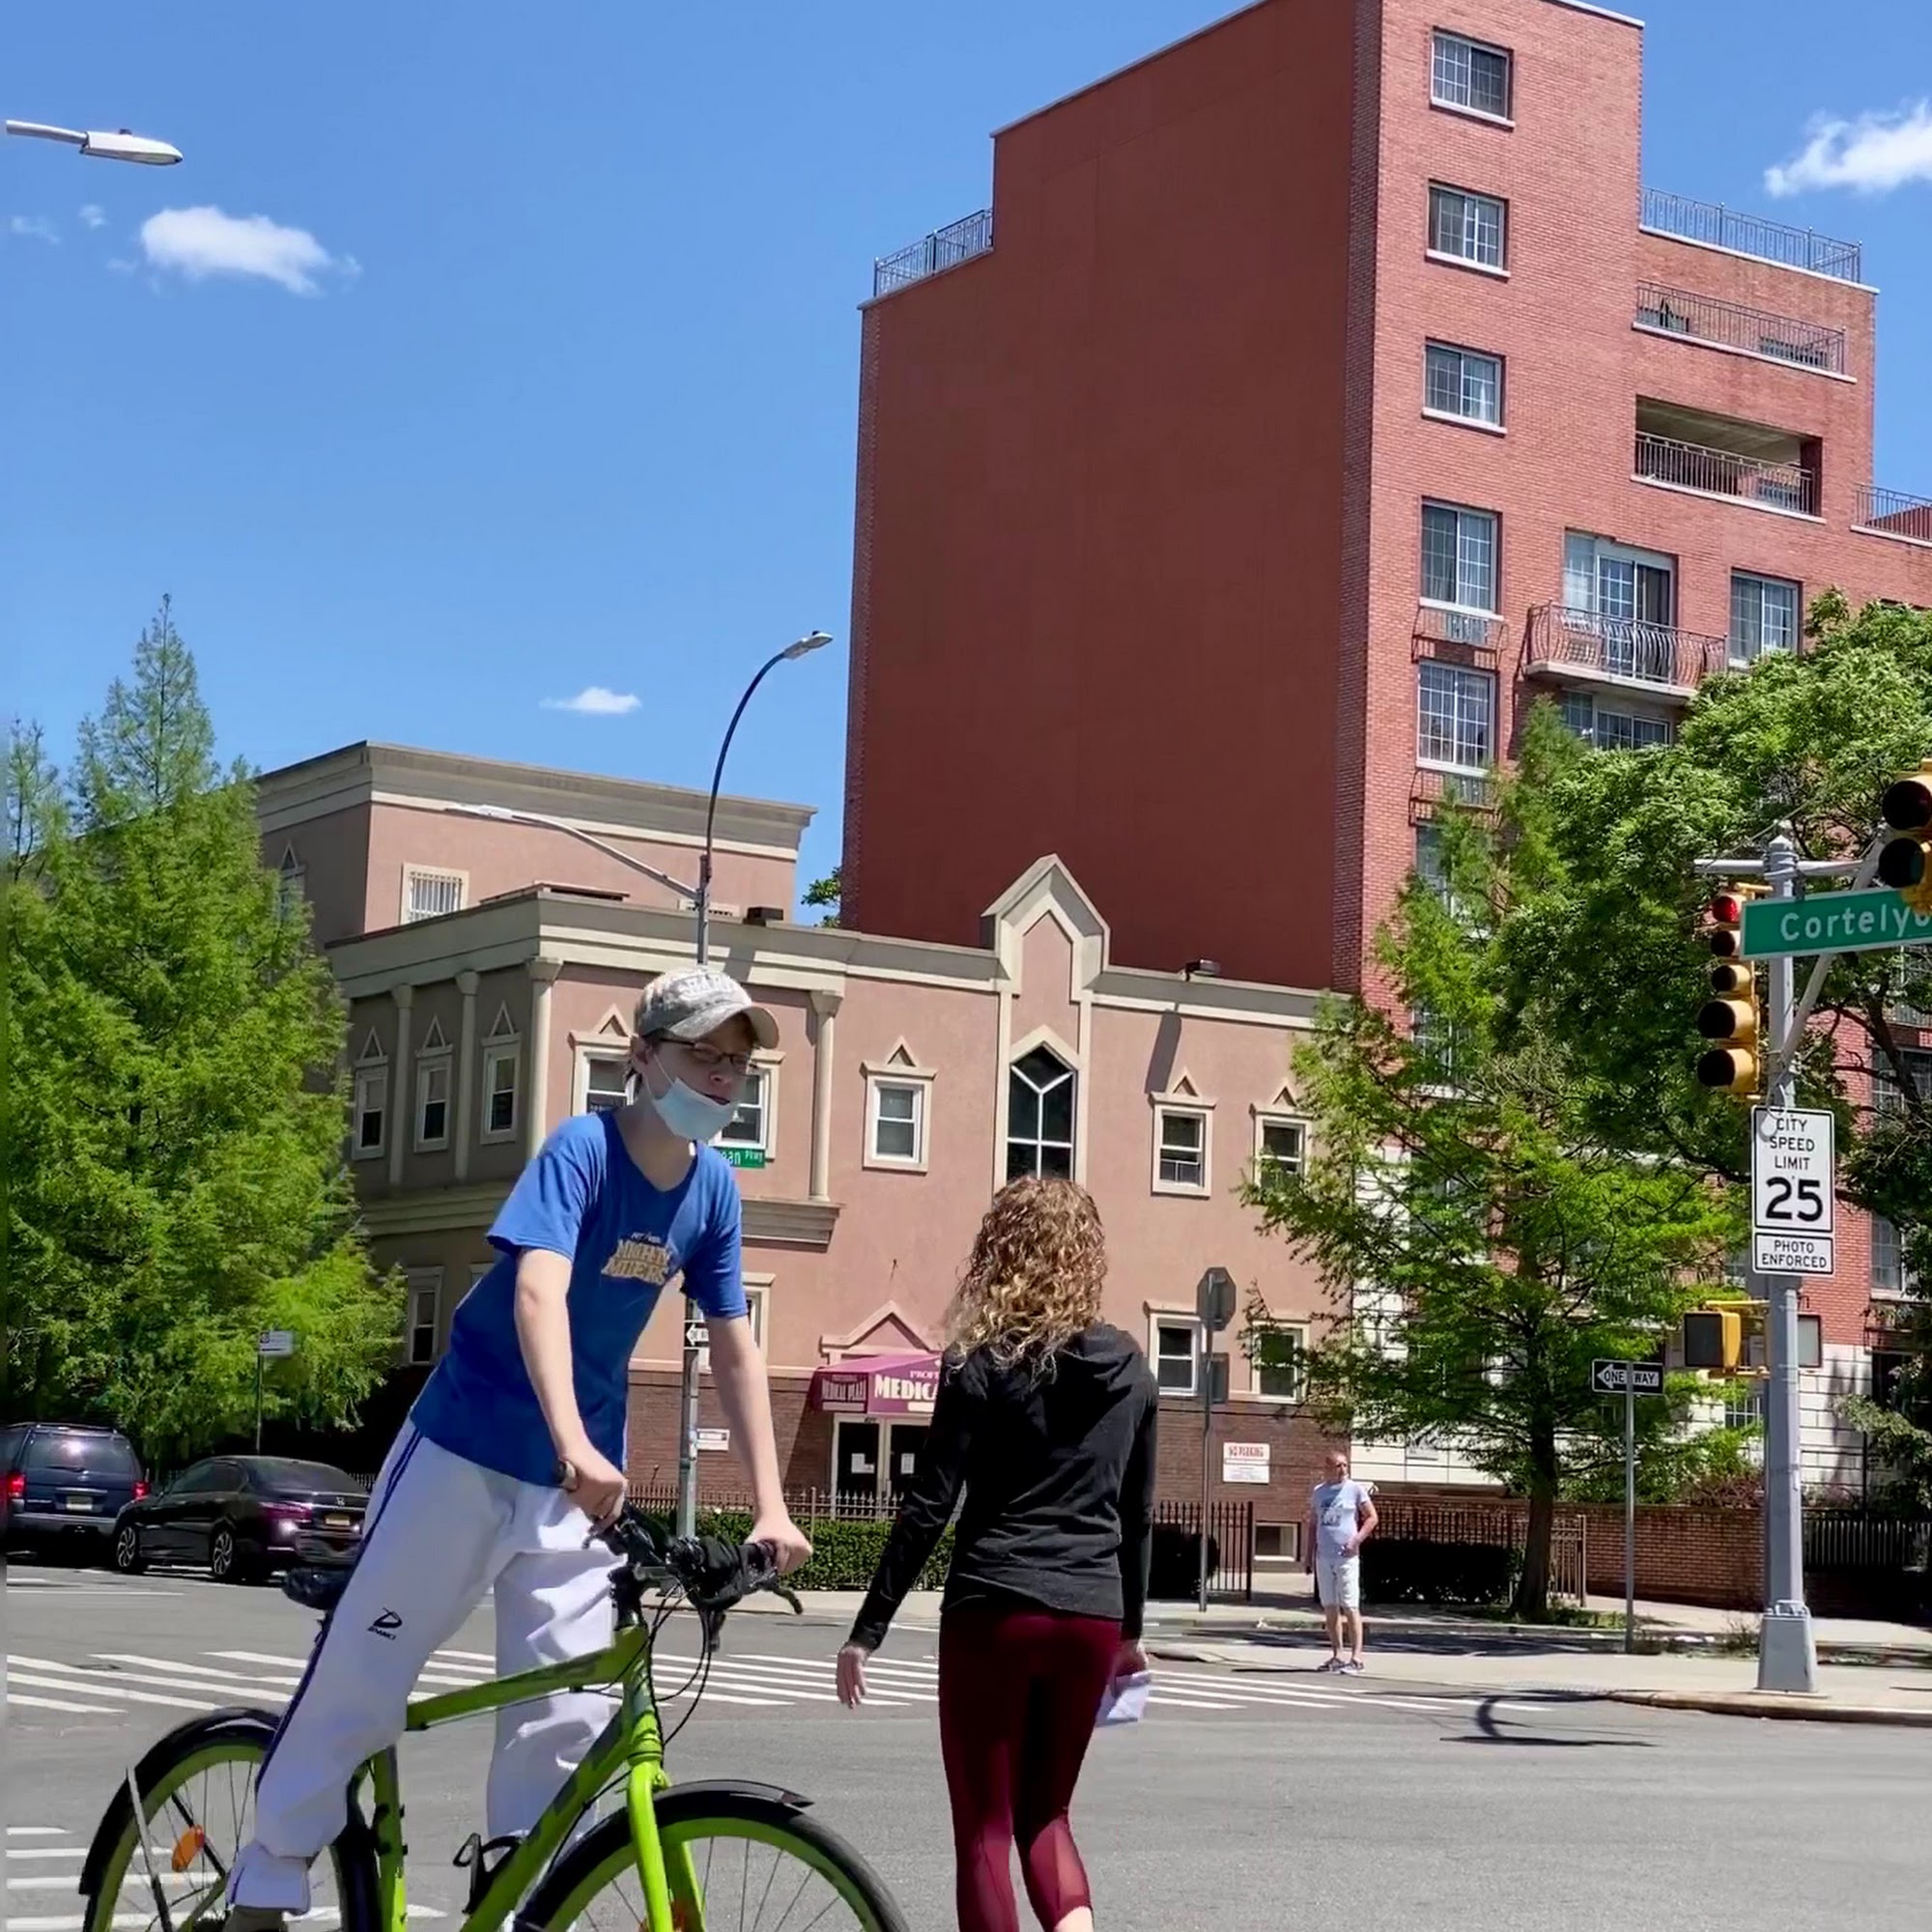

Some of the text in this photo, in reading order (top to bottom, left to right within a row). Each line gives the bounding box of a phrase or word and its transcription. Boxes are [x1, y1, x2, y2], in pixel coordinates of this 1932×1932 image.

[1776, 1118, 1807, 1132] CITY
[1770, 1136, 1815, 1151] SPEED
[1775, 1156, 1810, 1171] LIMIT
[1765, 1176, 1823, 1222] 25
[1774, 1240, 1814, 1254] PHOTO
[1762, 1253, 1827, 1268] ENFORCED
[1604, 1370, 1657, 1384] ONE WAY
